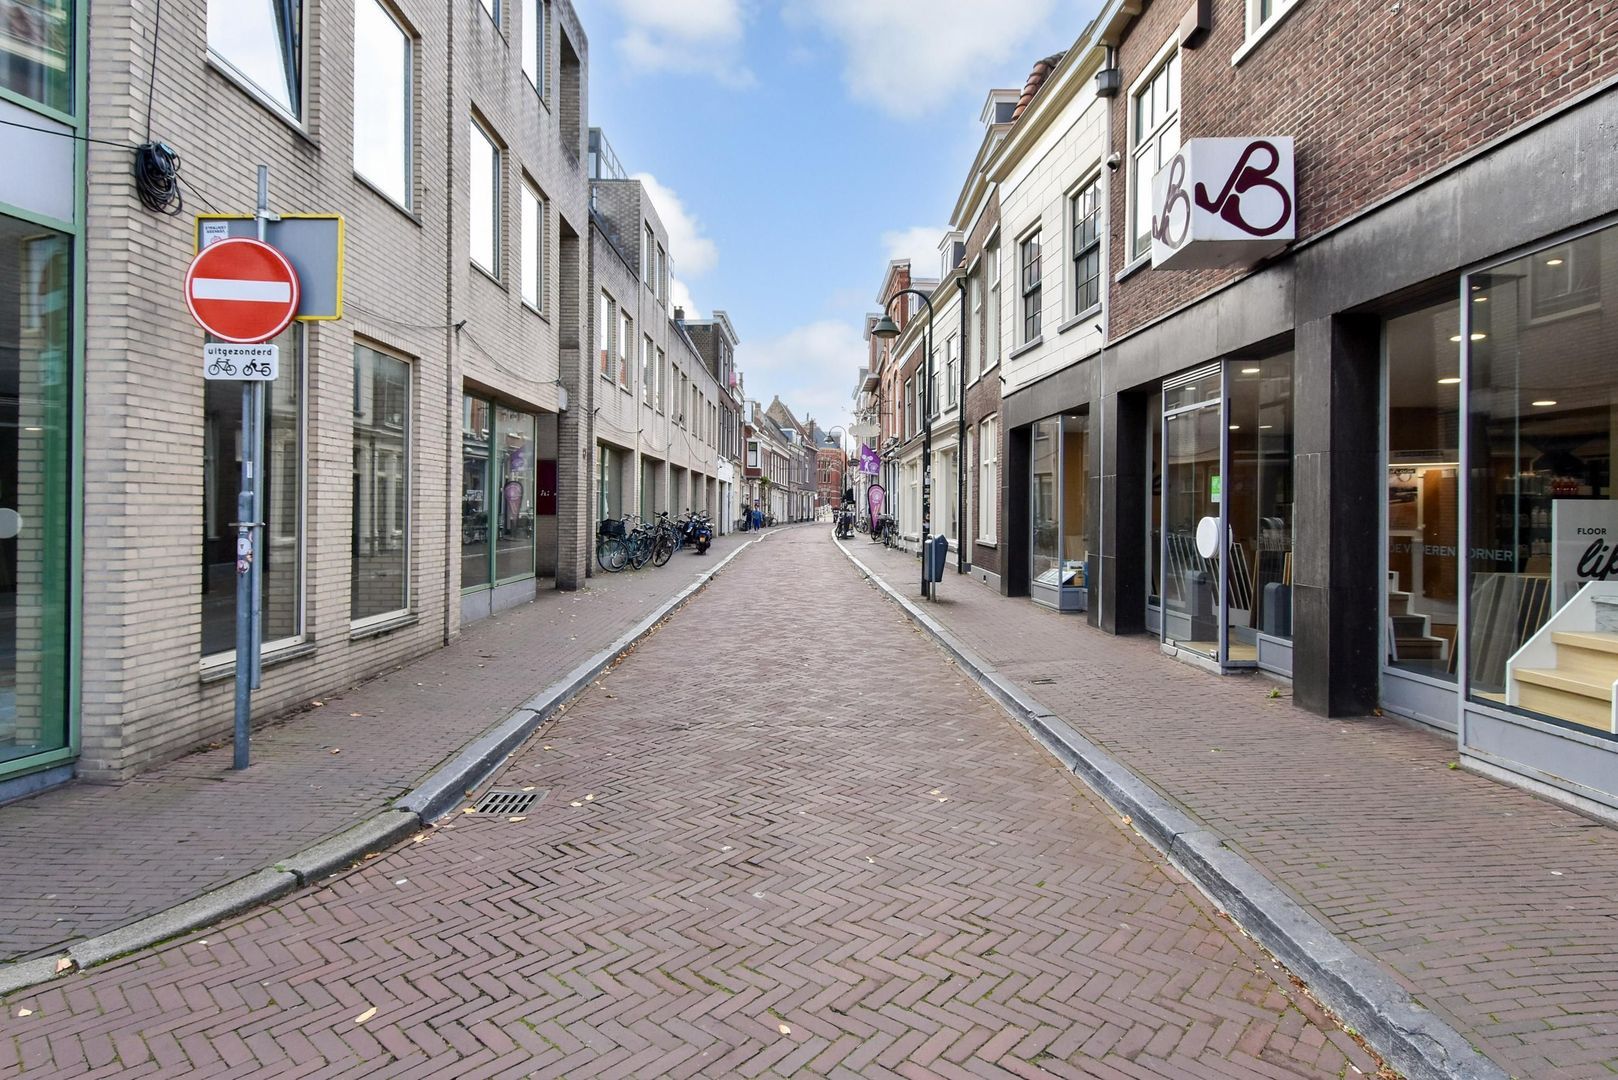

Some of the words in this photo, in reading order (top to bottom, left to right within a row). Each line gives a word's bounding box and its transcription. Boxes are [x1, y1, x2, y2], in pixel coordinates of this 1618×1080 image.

[208, 348, 272, 357] uitgezonderd
[1577, 527, 1607, 535] FLOOR
[1402, 543, 1456, 557] VEREN
[1469, 547, 1513, 561] ORNER
